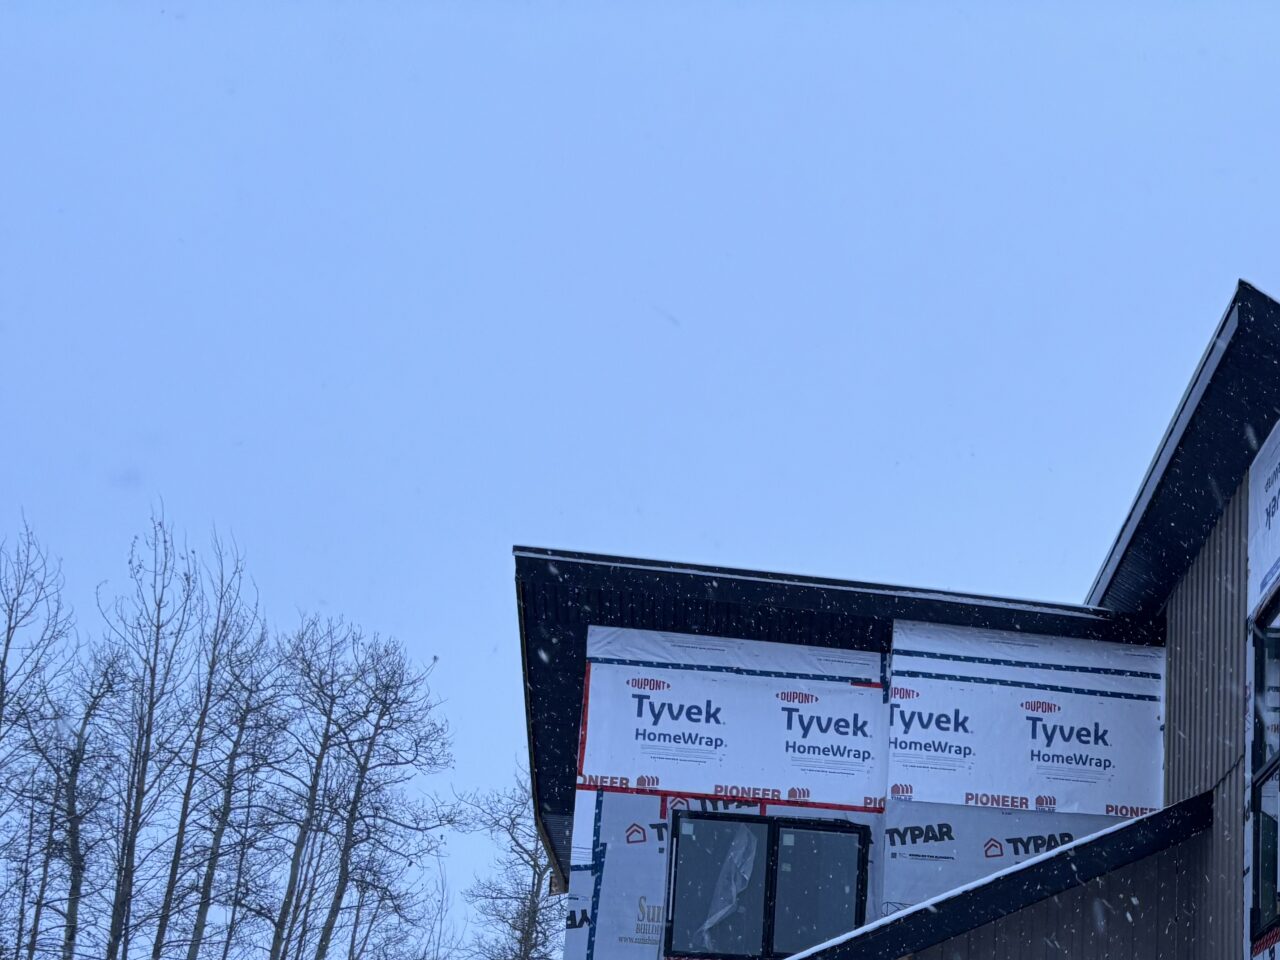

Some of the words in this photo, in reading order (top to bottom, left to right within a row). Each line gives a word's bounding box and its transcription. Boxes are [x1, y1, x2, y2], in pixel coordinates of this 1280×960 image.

[631, 678, 667, 691] DUPONT
[780, 691, 815, 704] DUPONT
[1025, 700, 1057, 713] DUPONT
[631, 694, 723, 725] Tyvek
[890, 703, 970, 734] Tyvek
[781, 707, 870, 738] Tyvek
[1026, 716, 1109, 747] Tyvek
[635, 728, 725, 749] HomeWrap
[889, 737, 972, 758] HomeWrap
[785, 741, 872, 762] HomeWrap
[1030, 750, 1112, 770] HomeWrap
[714, 785, 781, 801] PIONEER
[965, 792, 1029, 809] PIONEER
[885, 823, 955, 846] TYPAR
